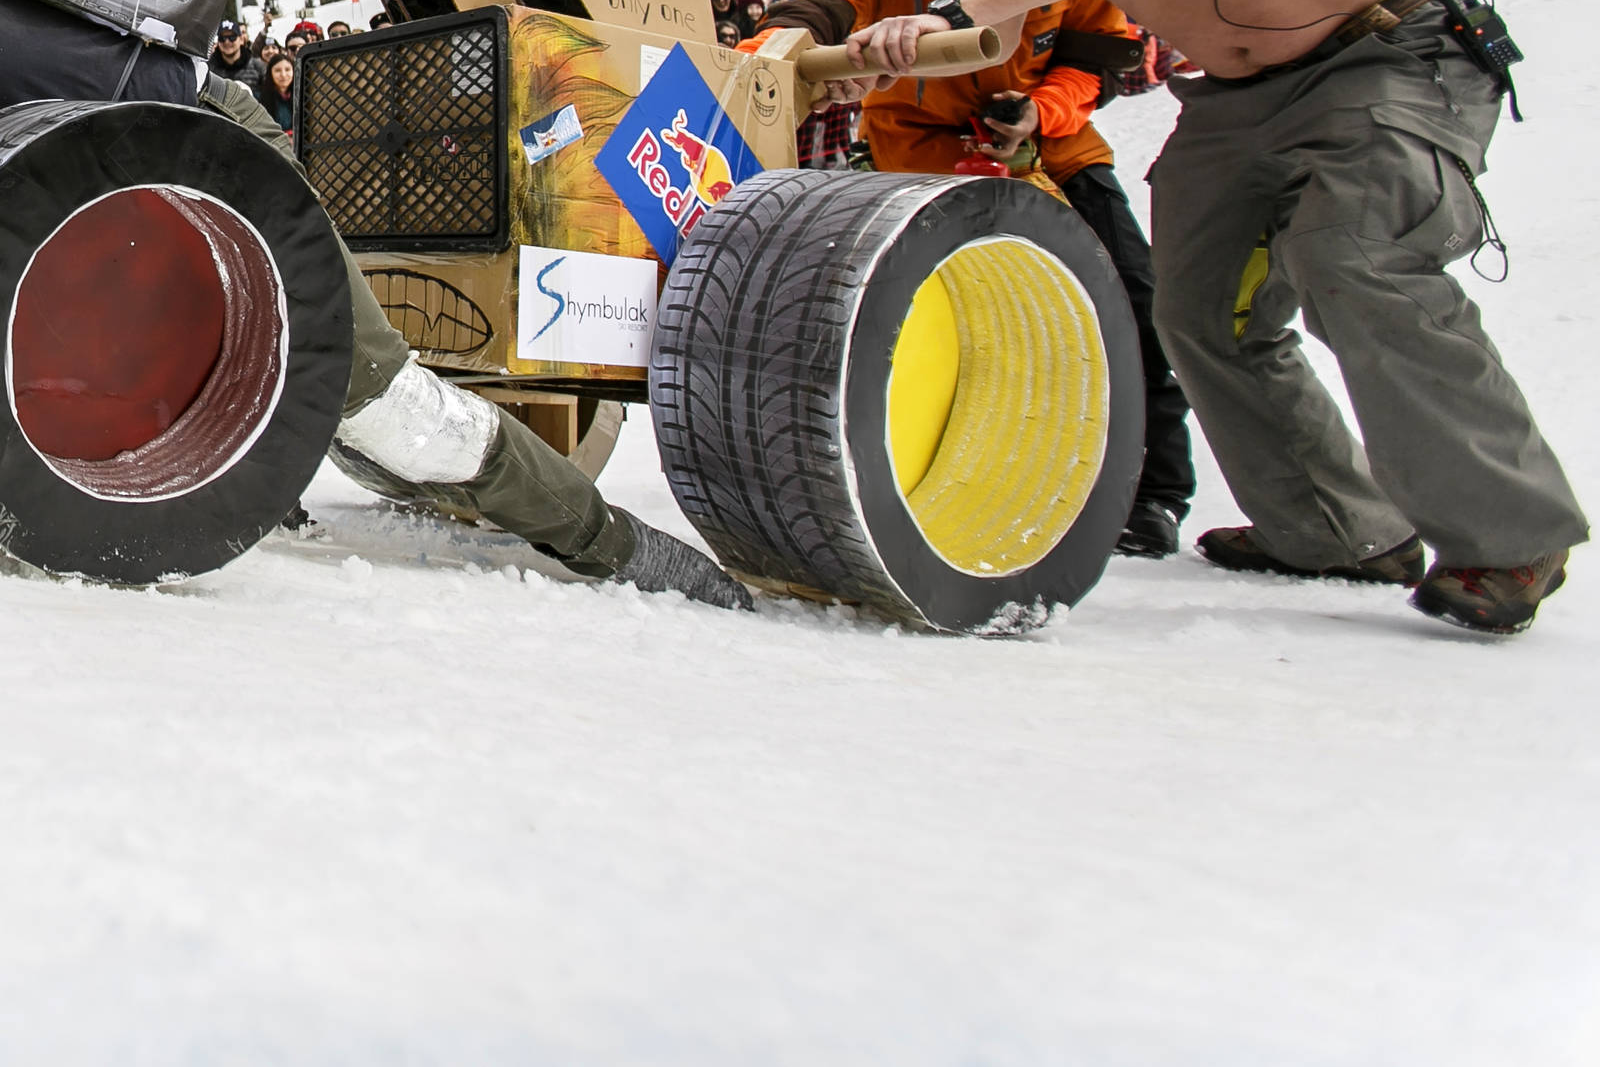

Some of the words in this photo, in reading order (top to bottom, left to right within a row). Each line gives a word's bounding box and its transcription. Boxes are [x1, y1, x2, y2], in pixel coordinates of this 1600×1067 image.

[661, 4, 697, 33] one
[627, 127, 696, 226] Red
[528, 255, 648, 344] Shymbulak
